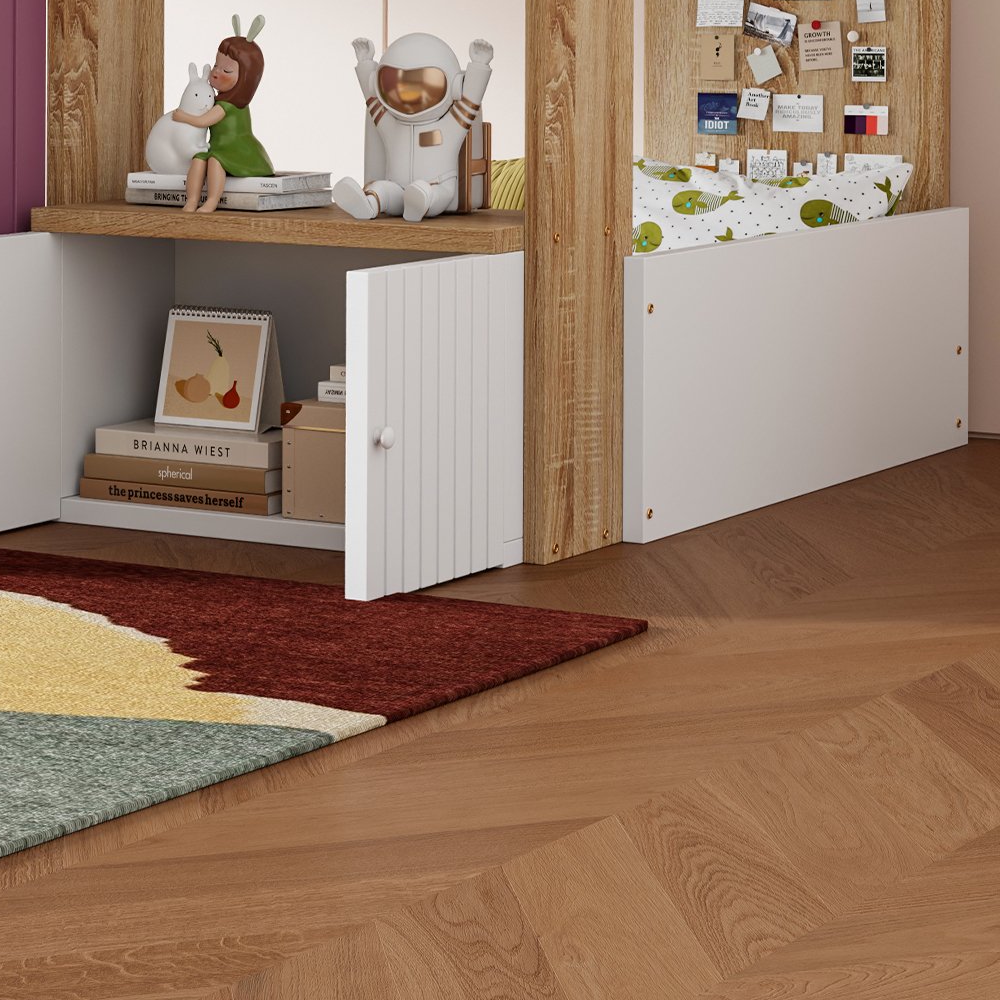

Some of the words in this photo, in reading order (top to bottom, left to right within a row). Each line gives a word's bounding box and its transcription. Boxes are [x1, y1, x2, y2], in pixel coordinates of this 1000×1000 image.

[747, 91, 770, 99] Another
[704, 120, 730, 130] IDIOT
[154, 192, 180, 202] BRINGING
[133, 439, 189, 455] BRIANNA
[194, 445, 231, 458] WIEST
[158, 466, 193, 480] spherical
